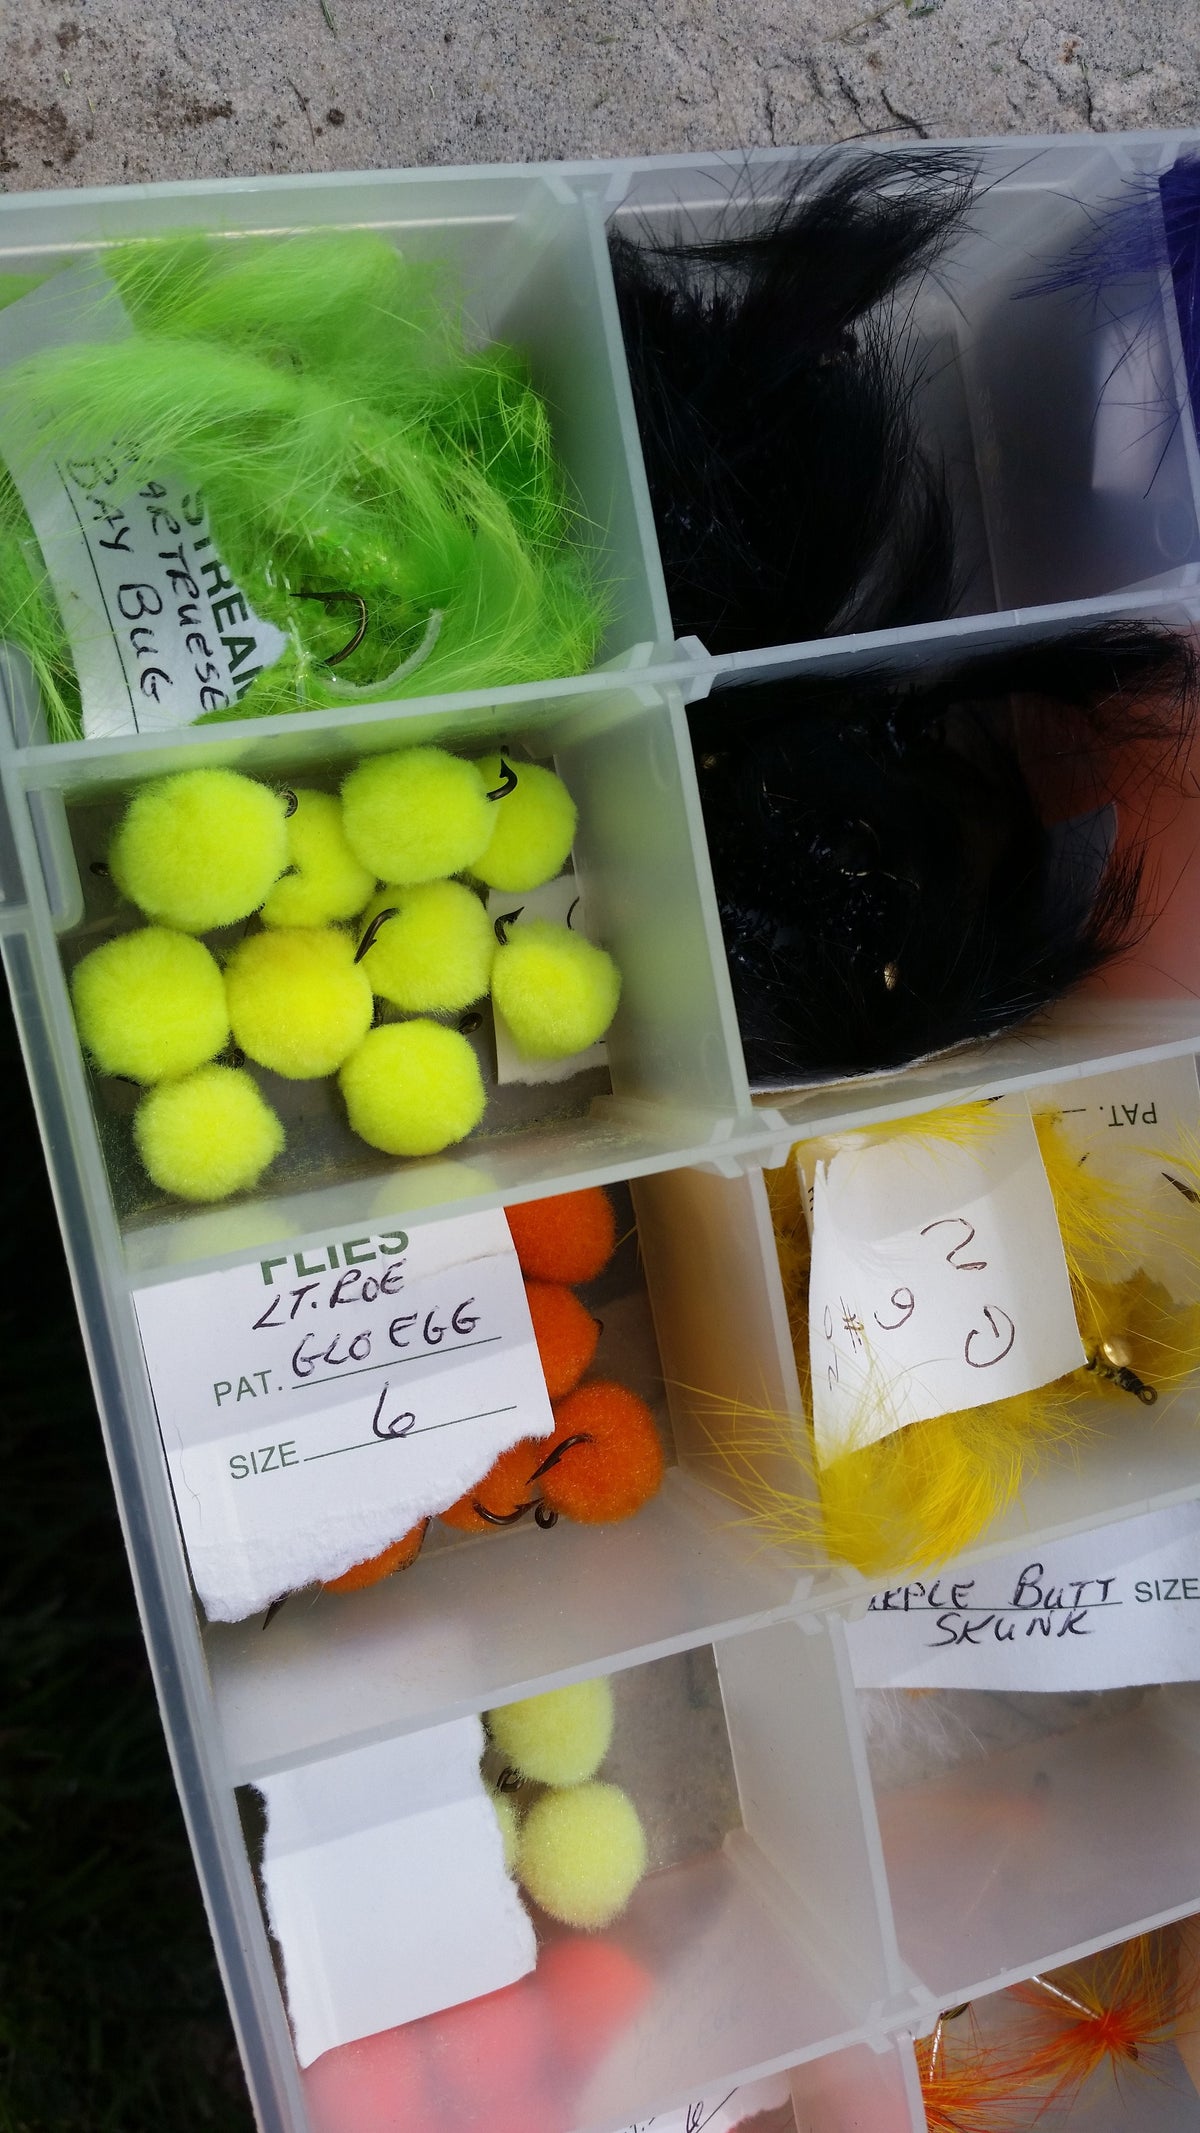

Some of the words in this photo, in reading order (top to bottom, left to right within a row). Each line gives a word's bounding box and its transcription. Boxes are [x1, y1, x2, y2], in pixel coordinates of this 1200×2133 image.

[117, 582, 173, 704] BUG
[1099, 1102, 1158, 1127] PAT.
[260, 1230, 410, 1285] FLIES
[329, 1258, 408, 1309] ROE
[291, 1330, 372, 1378] GLO
[388, 1297, 482, 1348] EGG
[213, 1370, 284, 1407] PAT.
[371, 1381, 416, 1439] 6
[229, 1441, 300, 1481] SIZE
[1135, 1578, 1200, 1603] SIZE
[927, 1610, 1095, 1648] SKUNK
